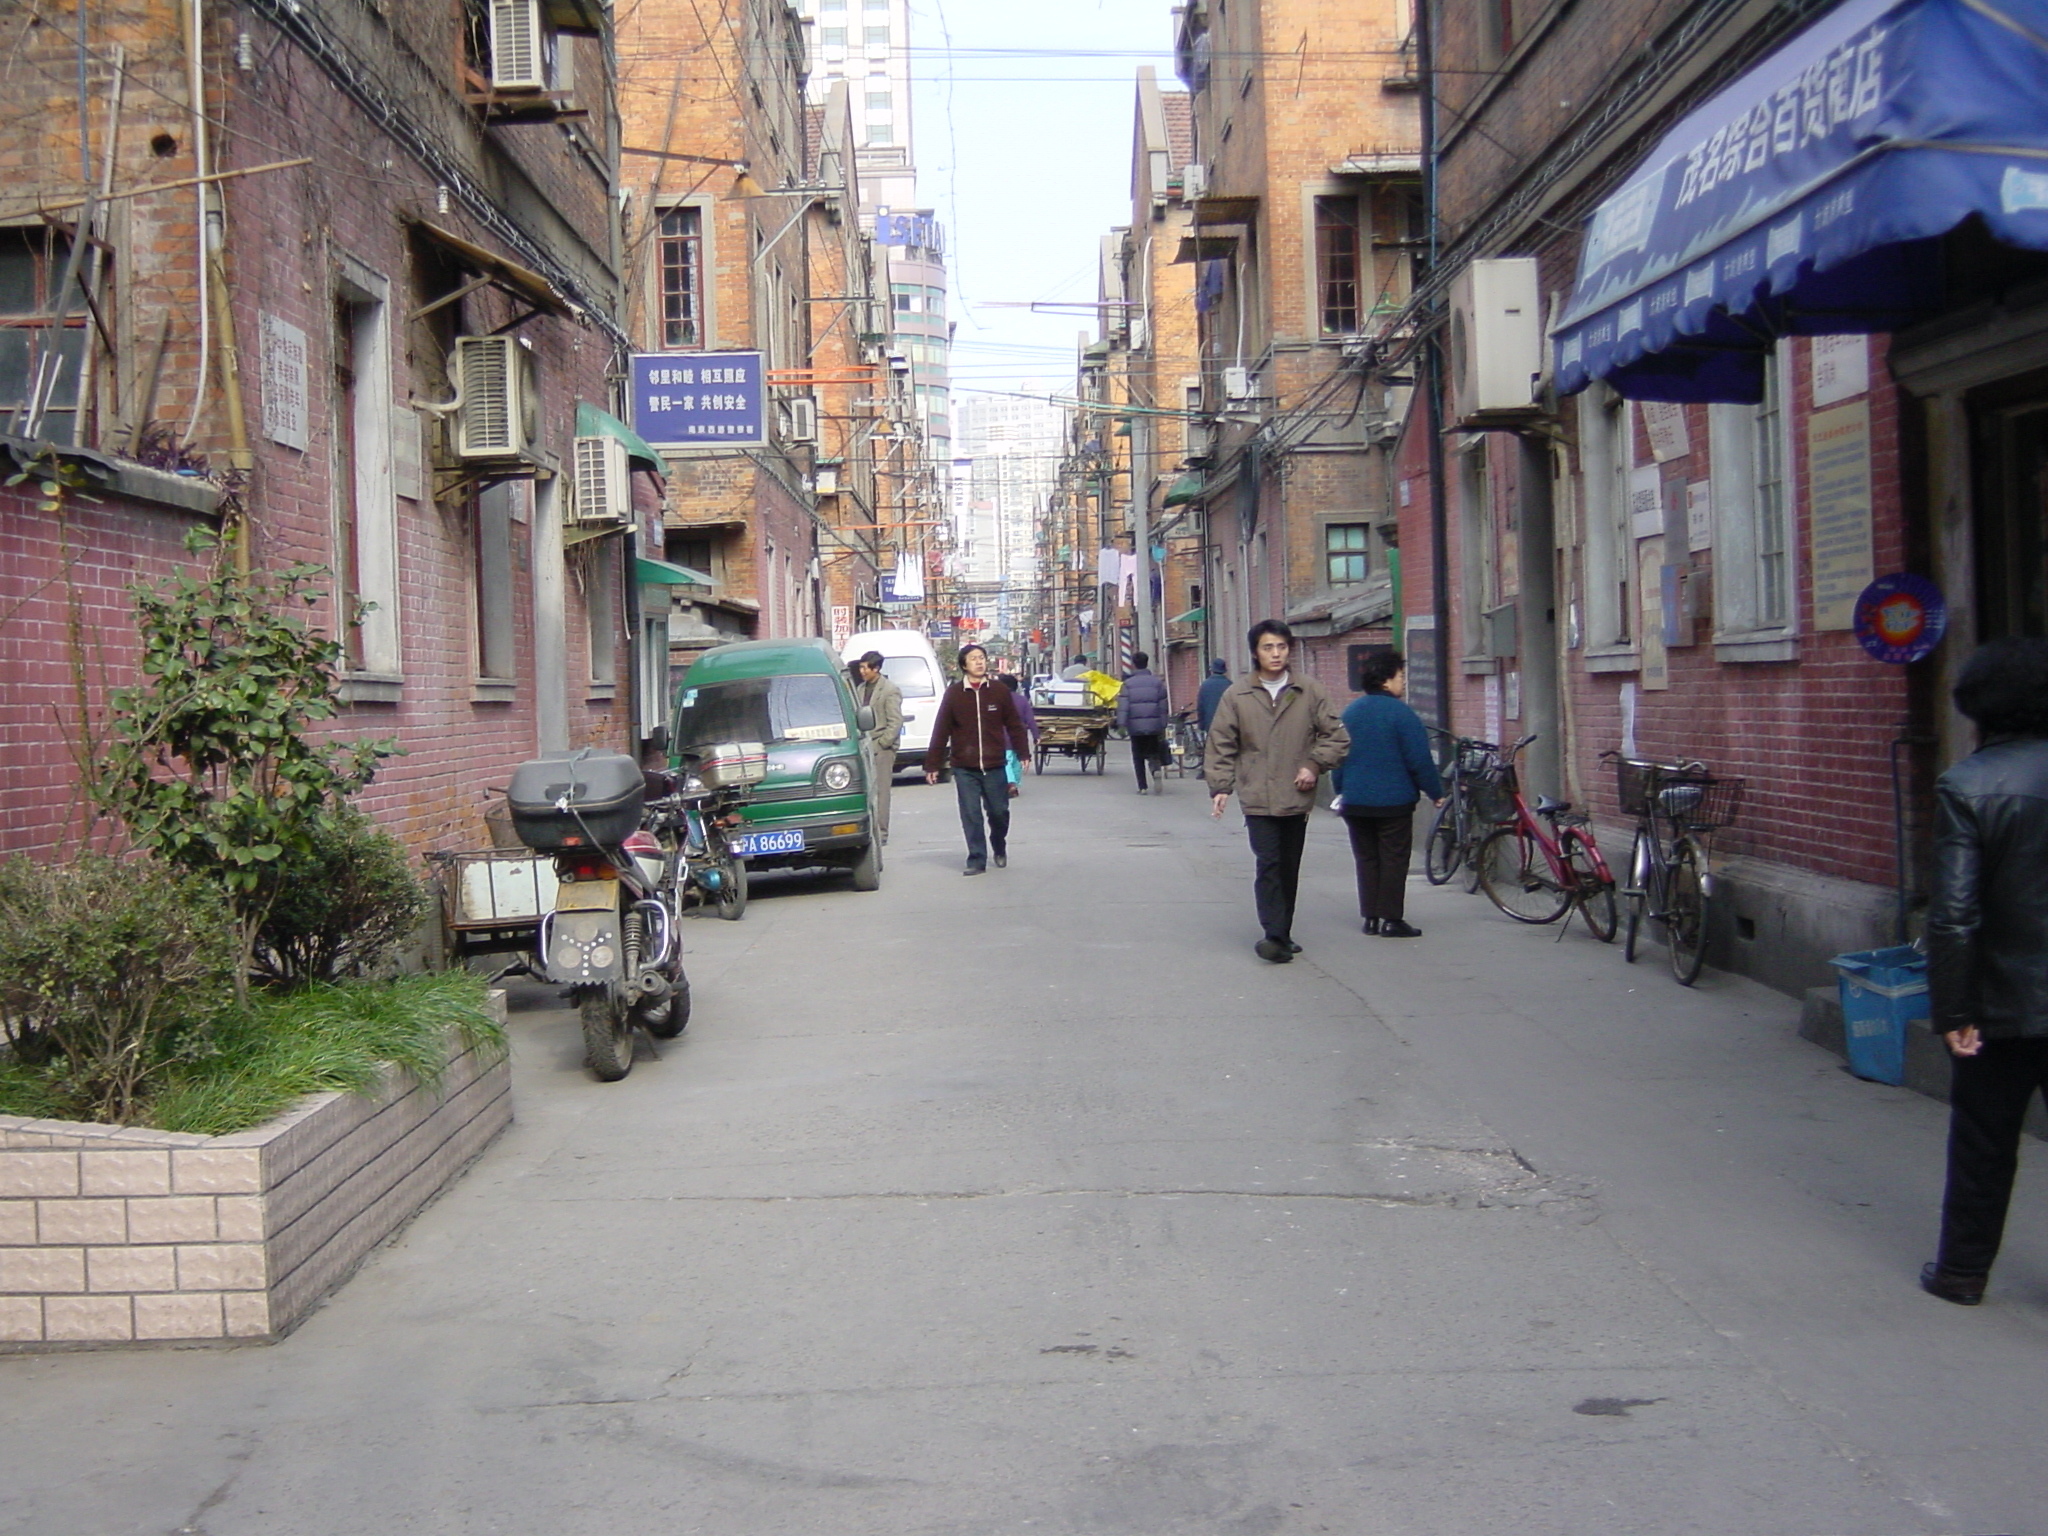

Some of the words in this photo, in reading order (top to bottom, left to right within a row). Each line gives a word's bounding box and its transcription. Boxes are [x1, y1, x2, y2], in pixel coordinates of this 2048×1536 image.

[648, 369, 695, 385] 邻里和睦
[648, 395, 695, 412] 警民一家
[700, 394, 747, 411] 共创安全
[760, 832, 802, 852] 86699
